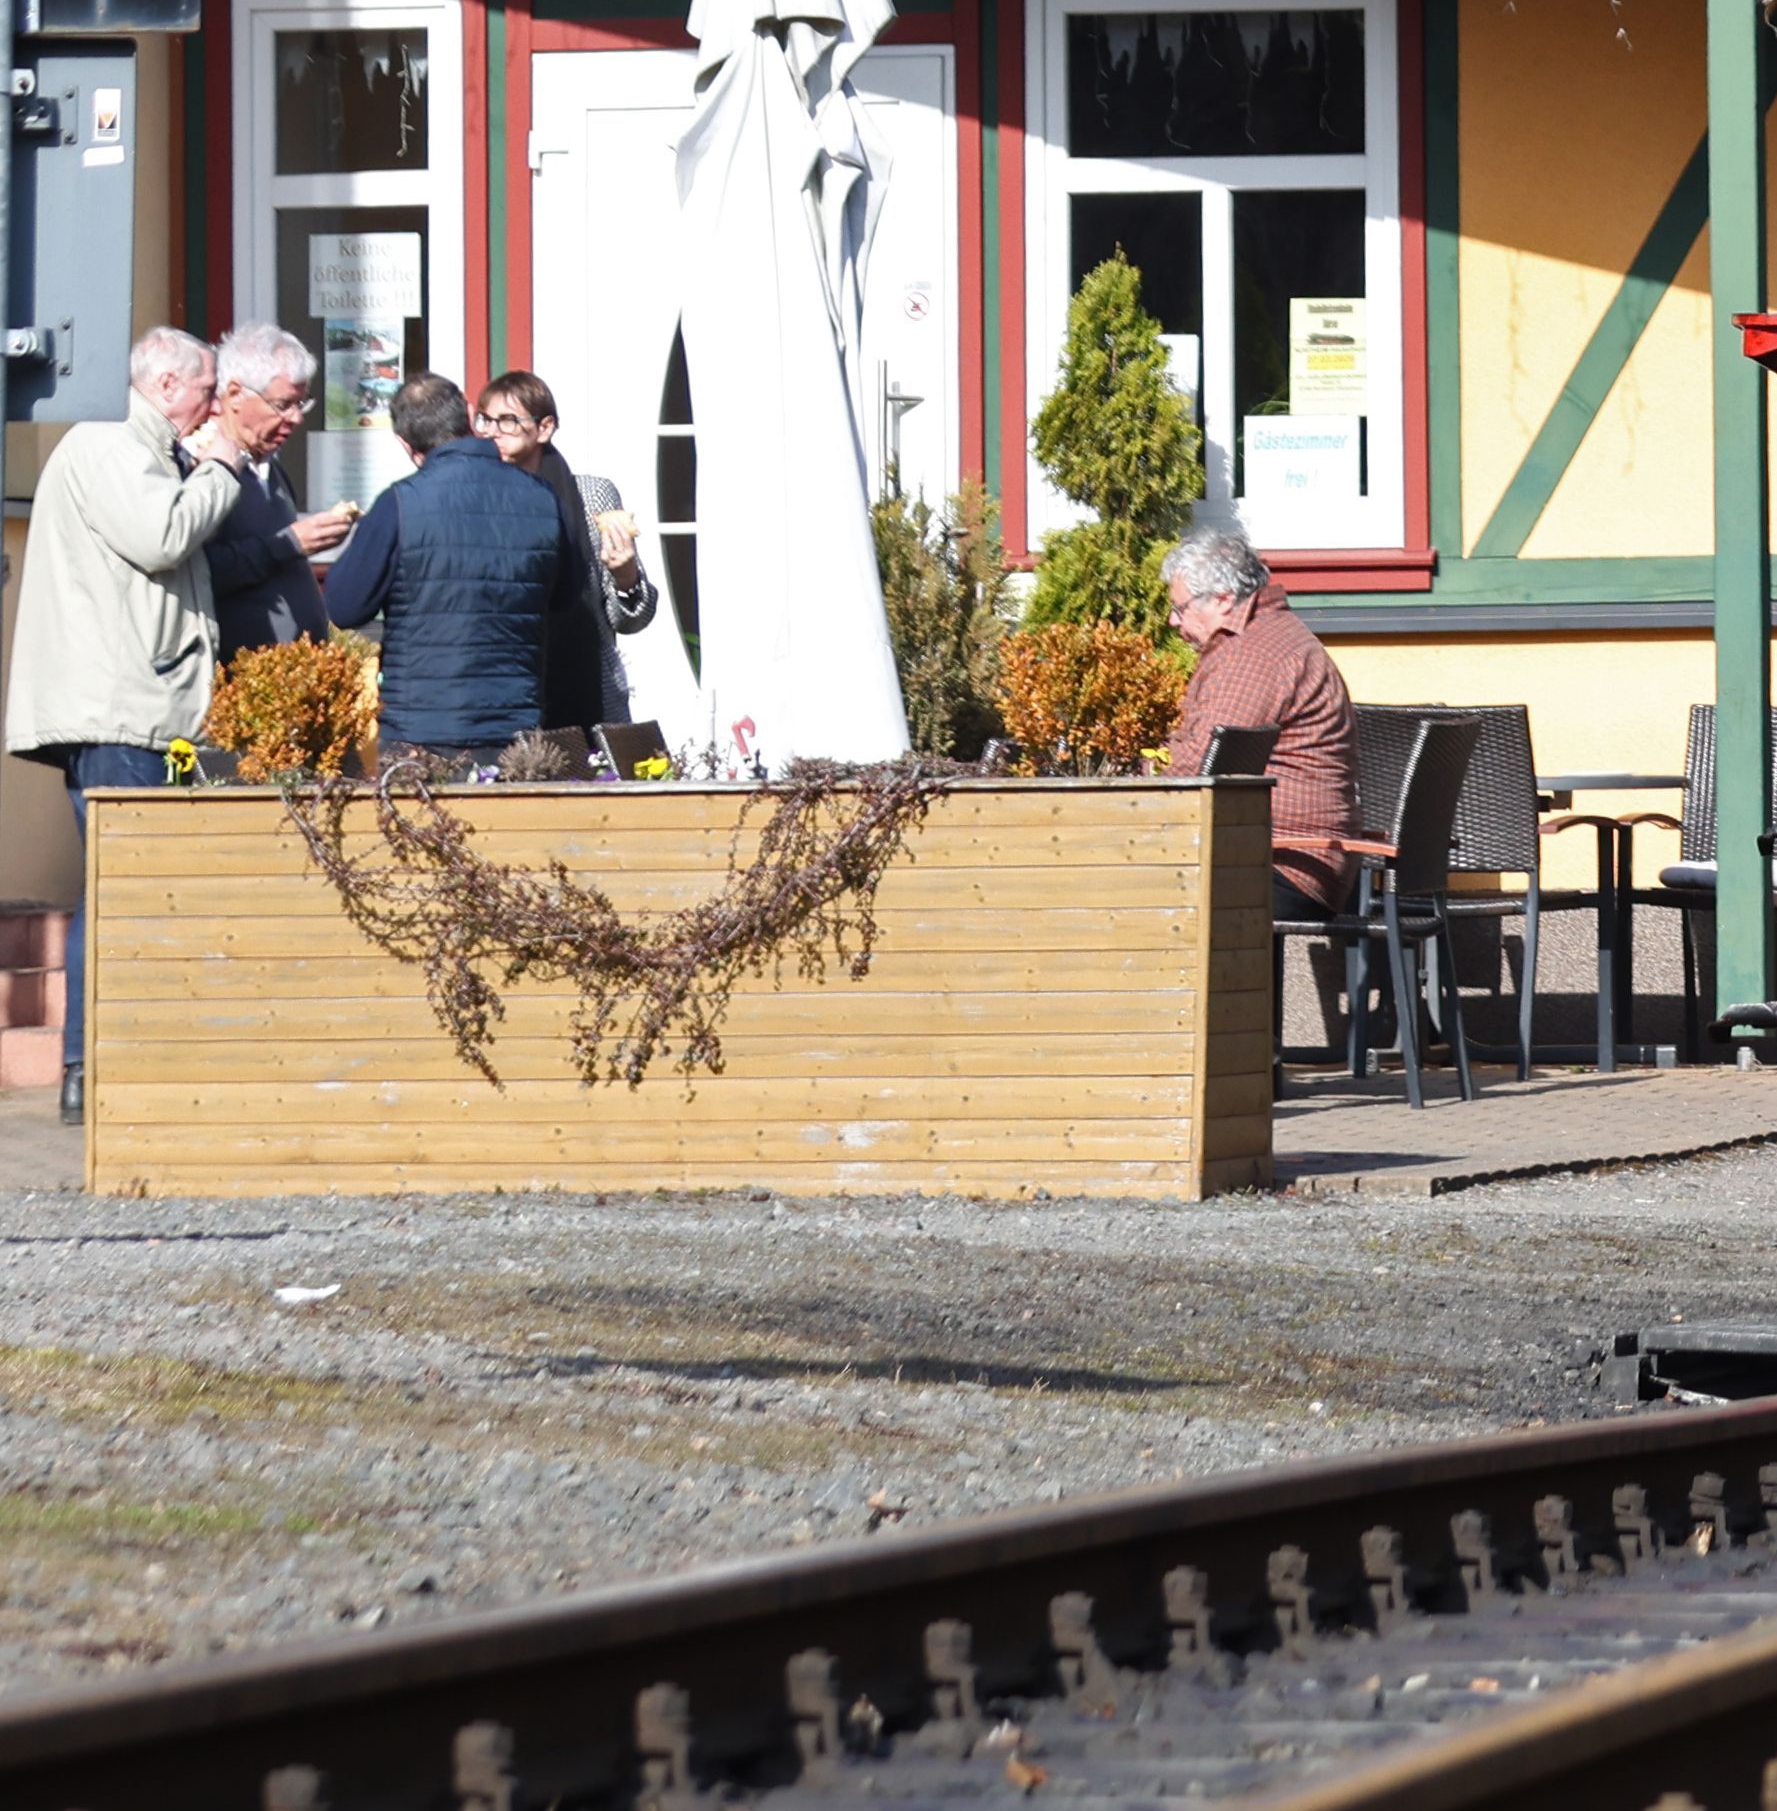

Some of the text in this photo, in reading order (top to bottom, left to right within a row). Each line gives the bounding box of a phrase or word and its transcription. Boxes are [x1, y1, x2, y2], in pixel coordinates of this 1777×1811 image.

[339, 238, 392, 257] Keine
[313, 263, 416, 283] öffentliche
[316, 290, 388, 308] Toilette
[1253, 431, 1349, 449] Gästezimmer
